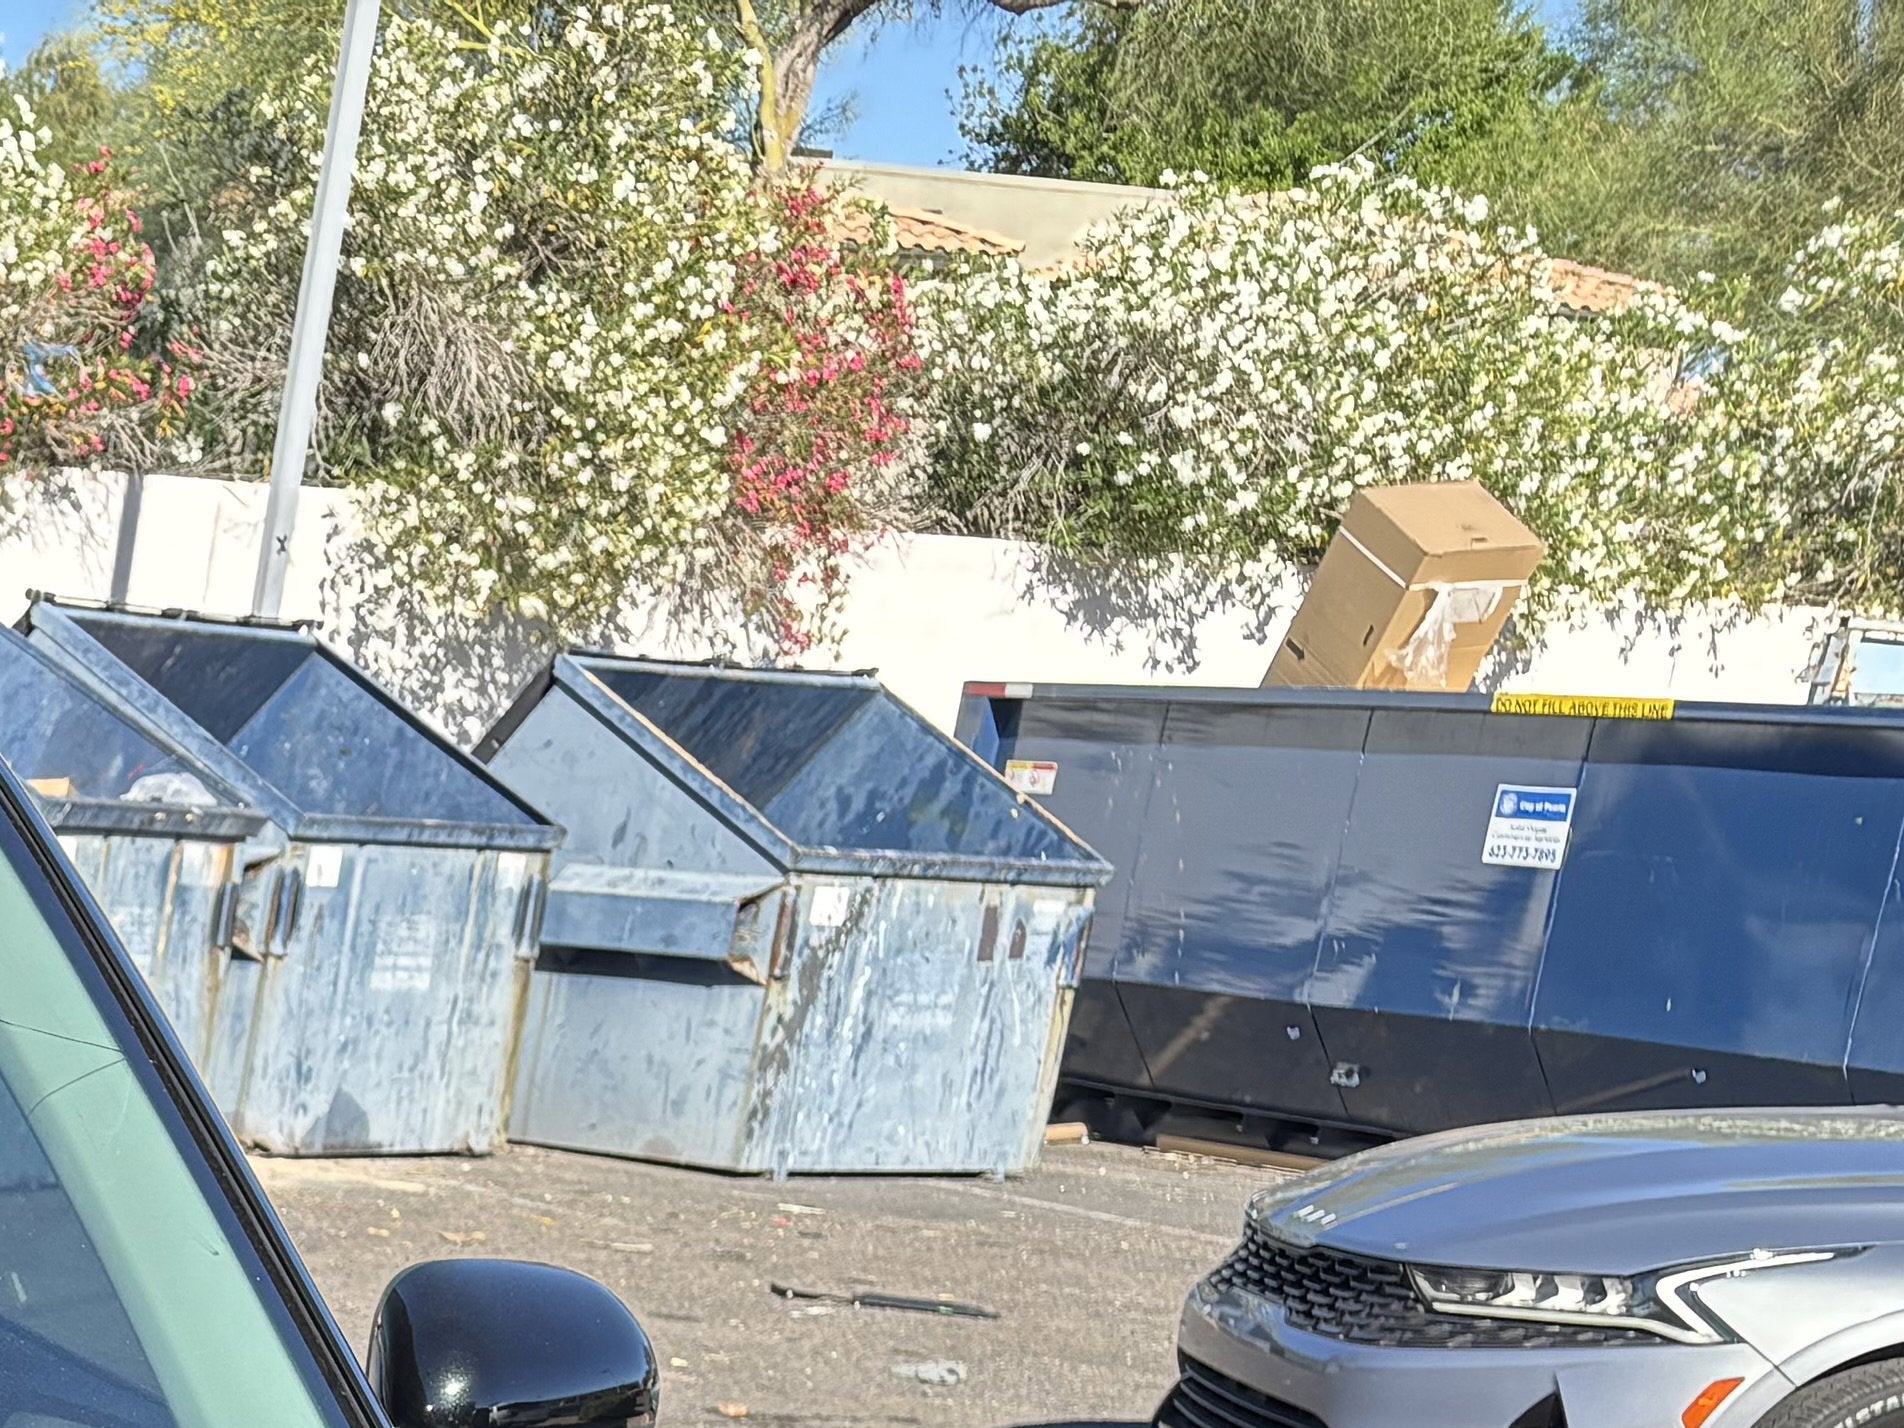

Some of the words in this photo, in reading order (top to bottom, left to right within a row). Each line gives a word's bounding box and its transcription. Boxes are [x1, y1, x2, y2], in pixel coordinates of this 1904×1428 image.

[1496, 697, 1512, 713] DO
[1515, 698, 1539, 714] NOT
[1542, 698, 1566, 715] FILL
[1568, 699, 1609, 717] ABOVE
[1613, 701, 1639, 718] THIS
[1640, 702, 1669, 720] LINE
